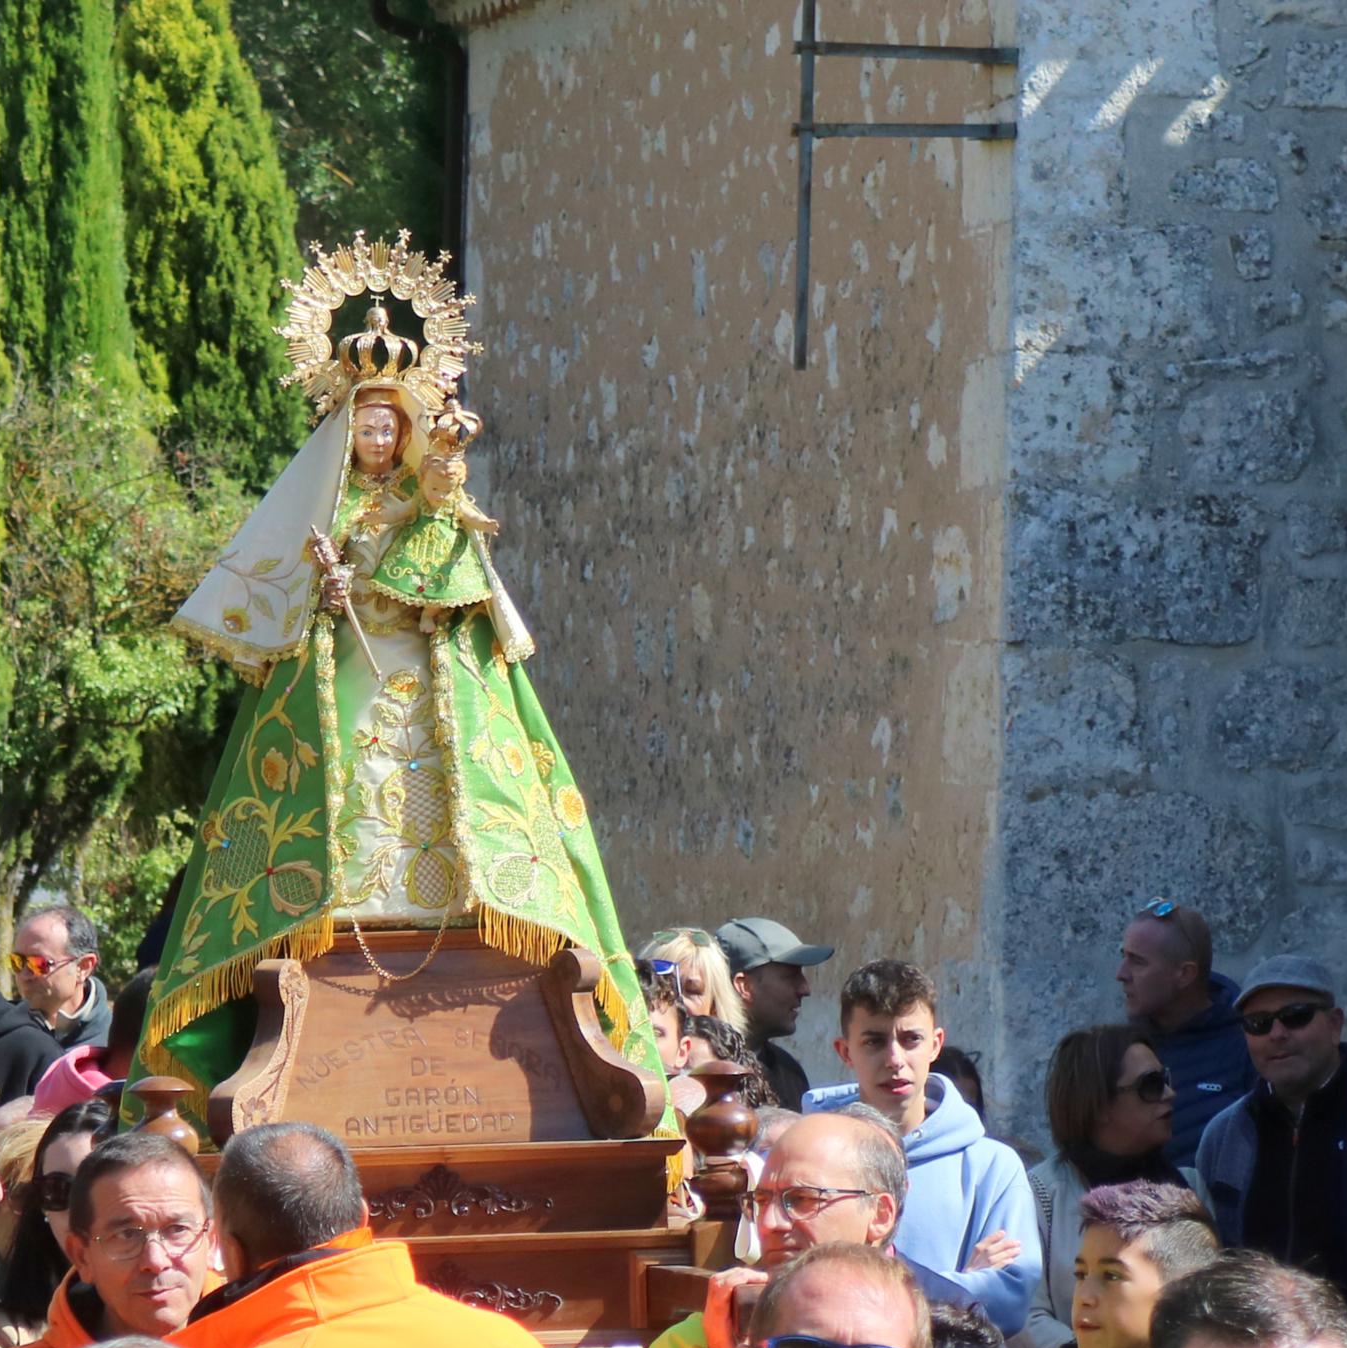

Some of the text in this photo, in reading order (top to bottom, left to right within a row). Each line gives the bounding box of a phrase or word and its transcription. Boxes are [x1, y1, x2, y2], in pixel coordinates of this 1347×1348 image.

[296, 1026, 563, 1091] NUESTRA SEÑORA
[410, 1056, 446, 1077] DE
[384, 1078, 481, 1107] GARÓN
[345, 1109, 515, 1137] ANTIGÜEDAD
